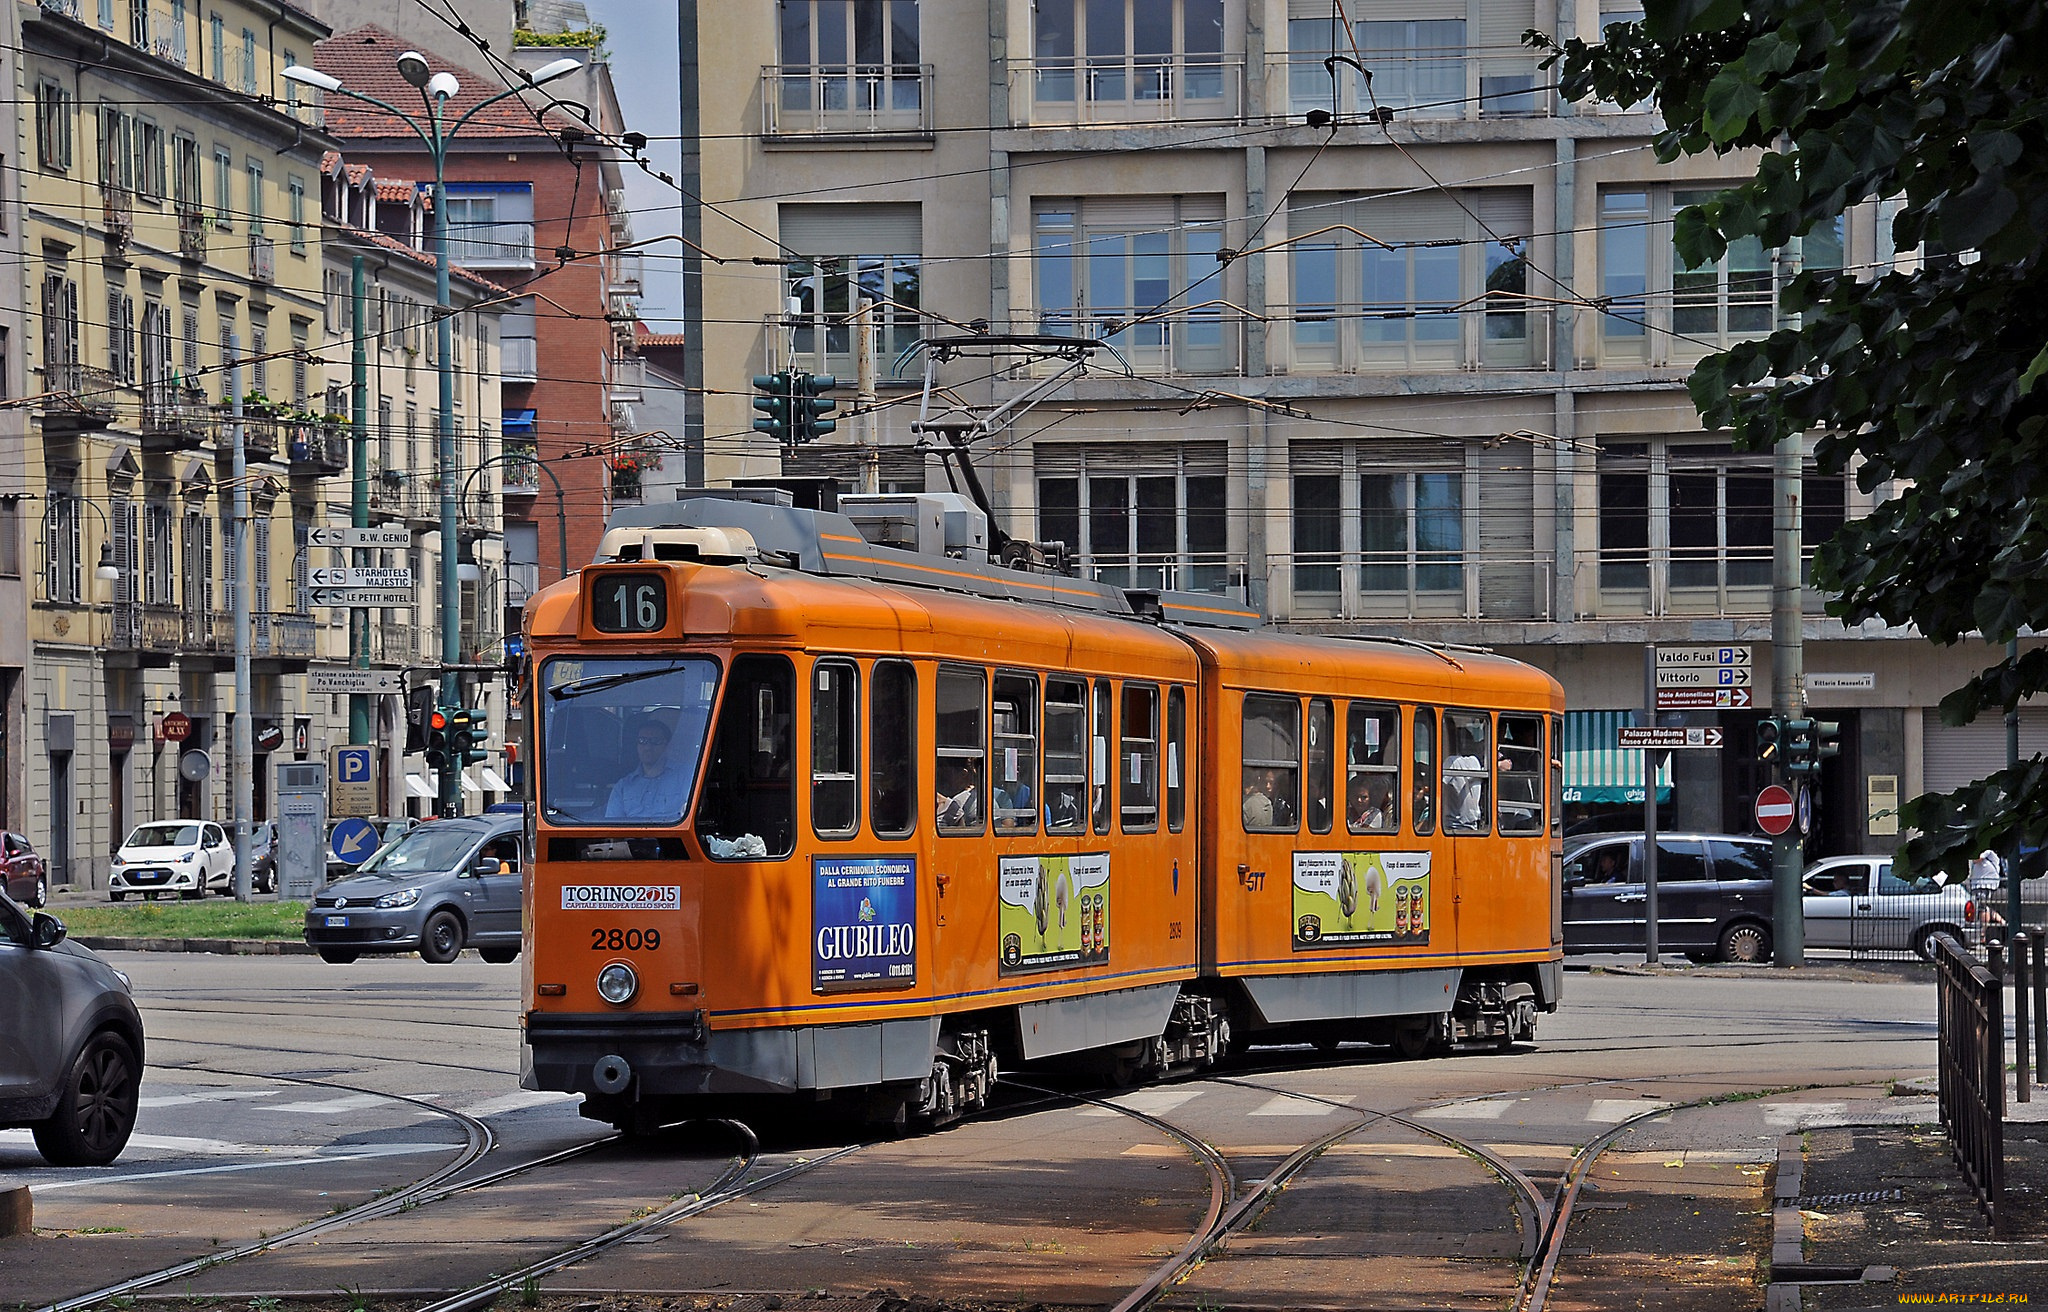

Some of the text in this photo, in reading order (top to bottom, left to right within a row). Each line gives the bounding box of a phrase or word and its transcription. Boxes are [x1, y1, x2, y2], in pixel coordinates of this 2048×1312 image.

[360, 534, 408, 542] B.W. GENIO
[356, 569, 408, 577] STARHOTELS
[614, 585, 657, 628] 16
[1660, 650, 1730, 662] Valdo Fusi P
[329, 679, 365, 687] Vanchiglia
[1660, 671, 1730, 683] Vittorio P
[346, 757, 362, 780] P
[820, 865, 910, 876] DALLA CERIMONIA ECONOMICA
[828, 877, 904, 888] AL GRANDE RITO FUNEBRE
[591, 928, 660, 950] 2809
[818, 923, 914, 960] GIUBILEO
